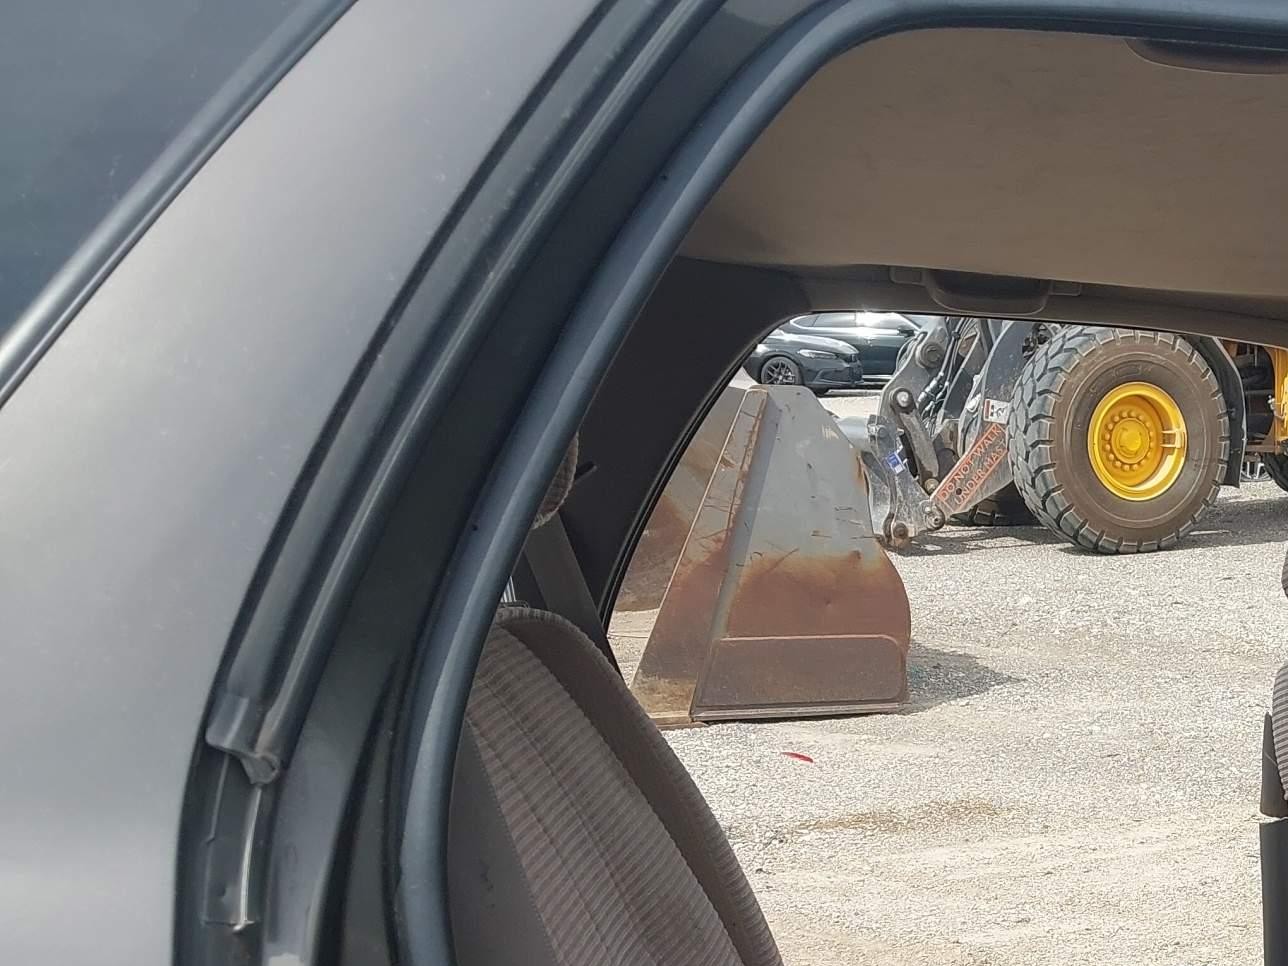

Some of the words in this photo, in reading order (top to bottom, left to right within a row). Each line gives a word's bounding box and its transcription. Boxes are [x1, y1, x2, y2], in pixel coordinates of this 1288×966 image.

[940, 483, 955, 500] DO
[954, 456, 974, 482] NOT
[973, 425, 1002, 457] WALK
[954, 468, 986, 505] UNDER
